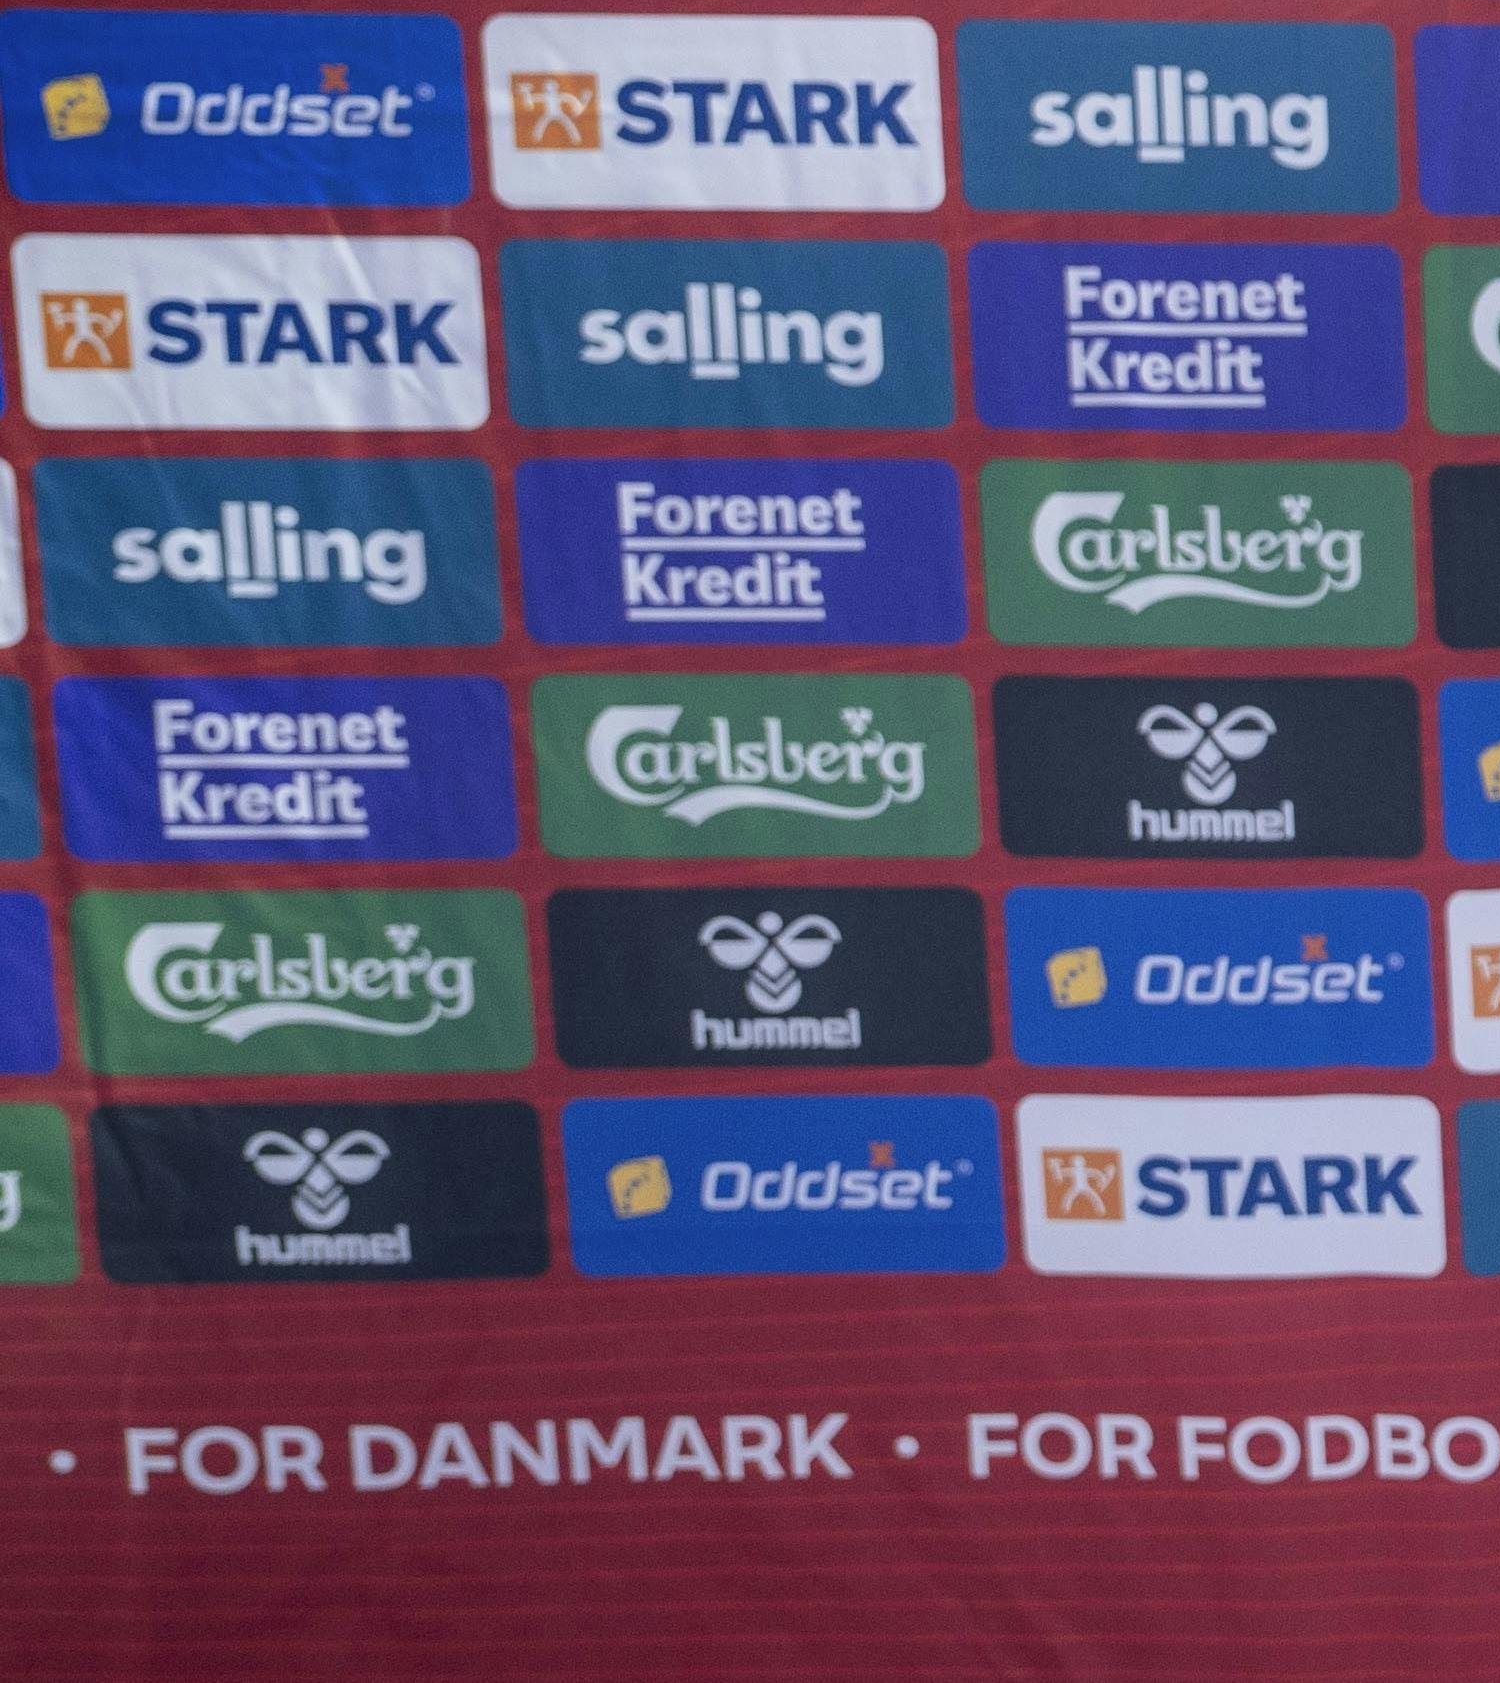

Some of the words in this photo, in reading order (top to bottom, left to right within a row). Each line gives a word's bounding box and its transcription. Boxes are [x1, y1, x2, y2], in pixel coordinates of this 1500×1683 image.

[615, 78, 916, 147] STARK
[1031, 65, 1330, 170] salling
[1065, 266, 1306, 320] Forenet
[145, 298, 459, 367] STARK
[580, 282, 885, 386] salling
[1069, 338, 1264, 392] Kredit
[618, 482, 864, 535] Forenet
[113, 501, 427, 604] salling
[622, 552, 824, 605] Kredit
[1030, 491, 1362, 614] Carlsberg
[155, 700, 407, 752] Forenet
[586, 704, 925, 825] Carlsberg
[160, 771, 367, 823] Kredit
[1128, 799, 1296, 842] hummel
[123, 921, 474, 1042] Carlsberg
[691, 1007, 862, 1050] hummel
[1136, 1155, 1420, 1219] STARK
[235, 1224, 412, 1265] hummel
[124, 1424, 327, 1495] FOR
[348, 1412, 853, 1491] DANMARK
[967, 1411, 1157, 1479] FOR
